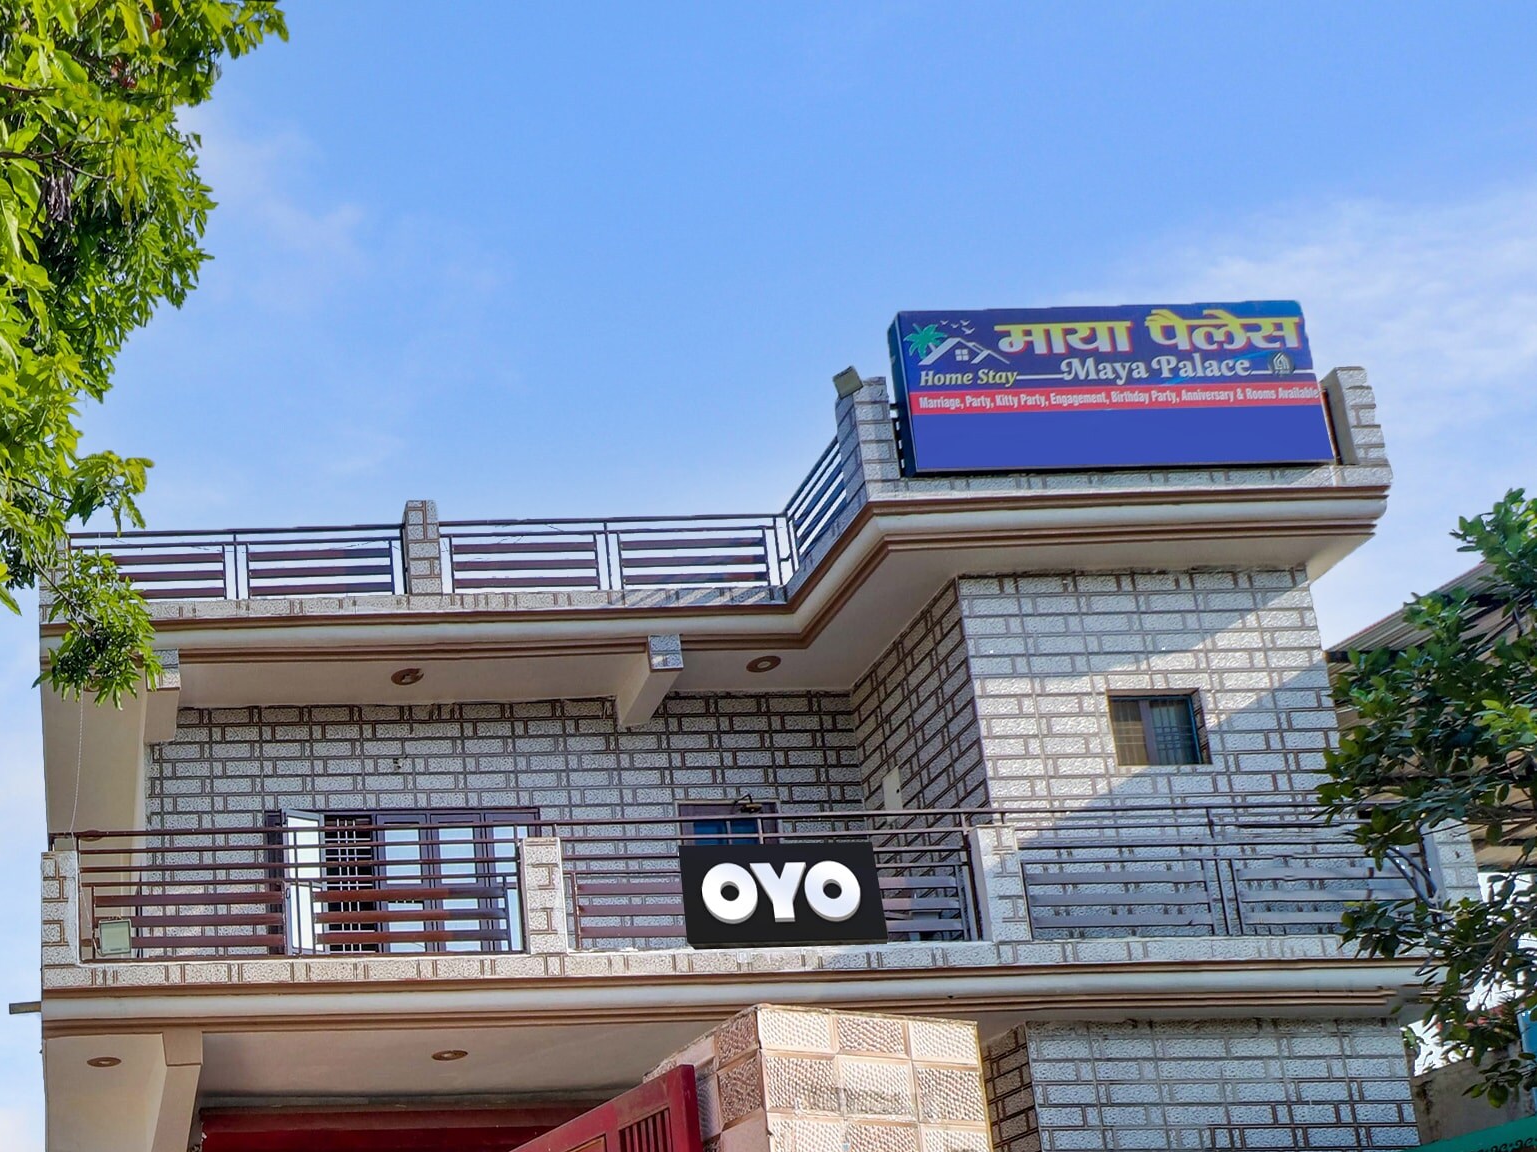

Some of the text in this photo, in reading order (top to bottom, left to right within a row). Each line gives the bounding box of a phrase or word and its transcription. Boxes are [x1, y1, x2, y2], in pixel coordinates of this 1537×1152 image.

[994, 308, 1304, 355] माया पैलेस
[920, 369, 1017, 387] Home Stay
[1060, 353, 1252, 386] Maya Palace
[919, 386, 1320, 410] Marriage, Party, Kitty Party, Engagement, Birthday Party, Anniversary & Rooms Available
[702, 861, 861, 924] OYO
